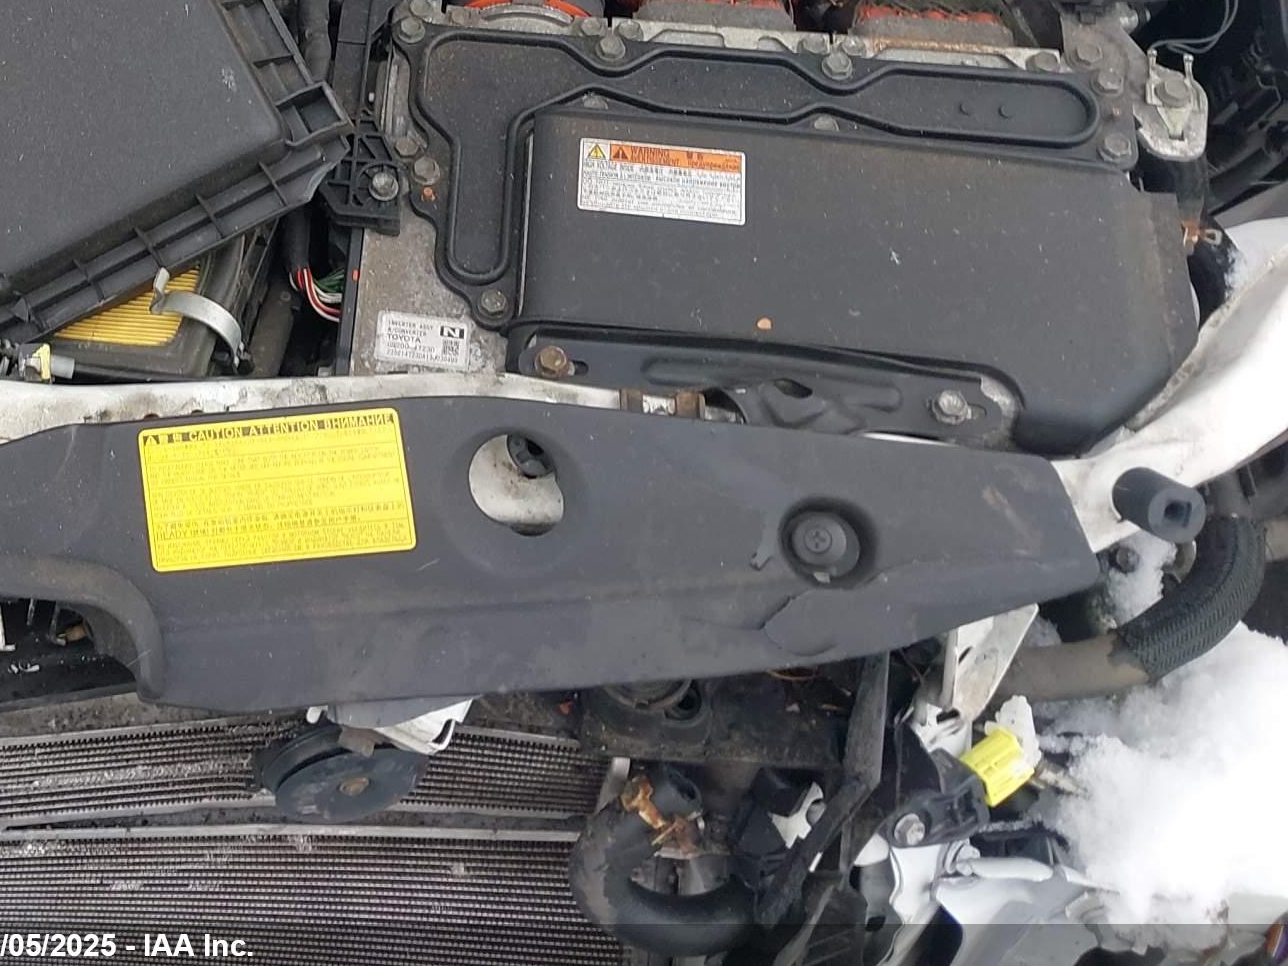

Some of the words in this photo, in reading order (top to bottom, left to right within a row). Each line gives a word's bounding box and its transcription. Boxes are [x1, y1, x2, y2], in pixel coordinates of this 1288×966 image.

[388, 319, 416, 328] INVERTER
[387, 333, 421, 343] TOYOTA
[189, 428, 243, 442] CAUTION
[249, 420, 320, 437] ATTENTION
[324, 413, 392, 431] ВНИМАНИЕ
